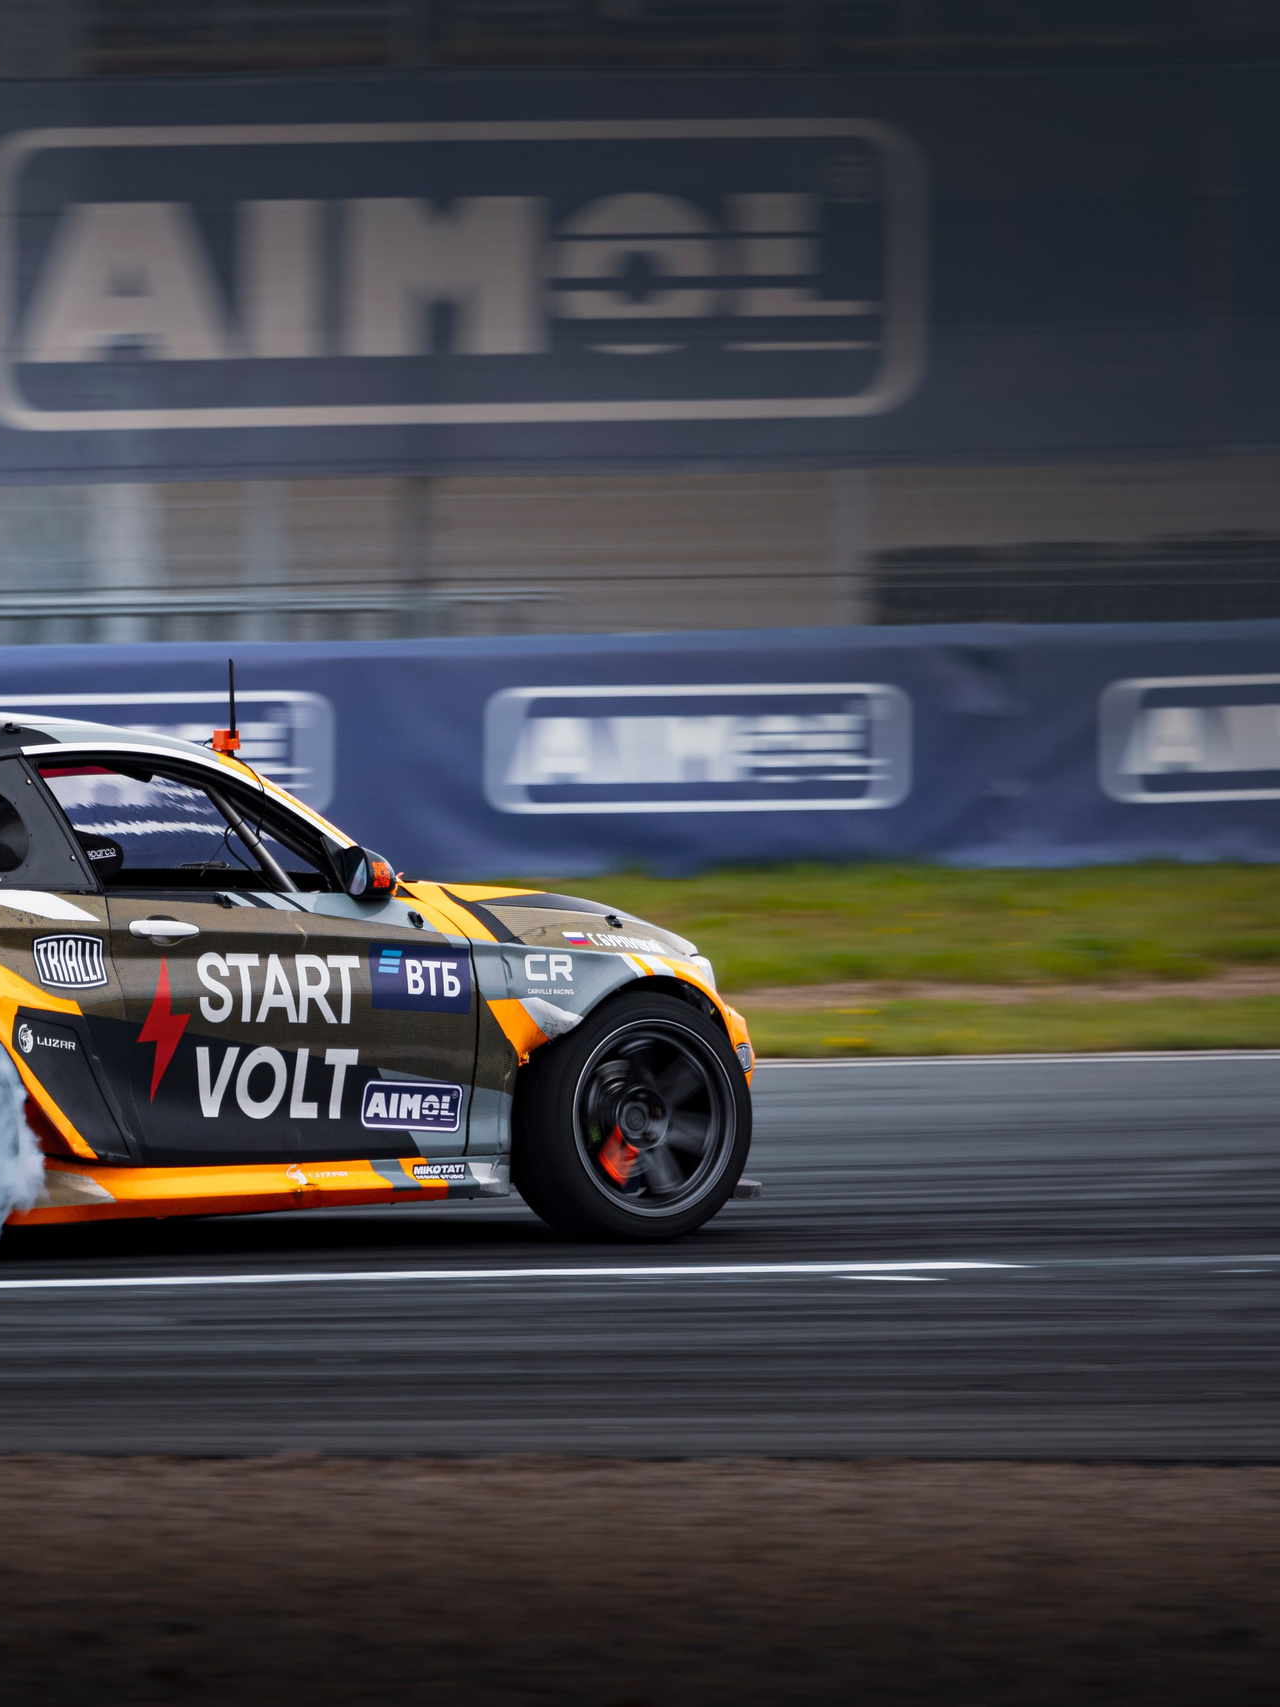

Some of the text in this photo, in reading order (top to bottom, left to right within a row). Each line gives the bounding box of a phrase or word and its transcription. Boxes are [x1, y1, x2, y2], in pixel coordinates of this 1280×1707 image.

[18, 192, 880, 364] AIMOL
[37, 939, 102, 982] TRIALLI
[405, 959, 461, 998] ВТБ
[524, 954, 573, 981] CR
[196, 952, 360, 1024] START
[36, 1035, 76, 1050] LUZAR
[196, 1046, 359, 1119] VOLT
[365, 1092, 455, 1121] AIMOL
[414, 1164, 465, 1175] MIKOTATI
